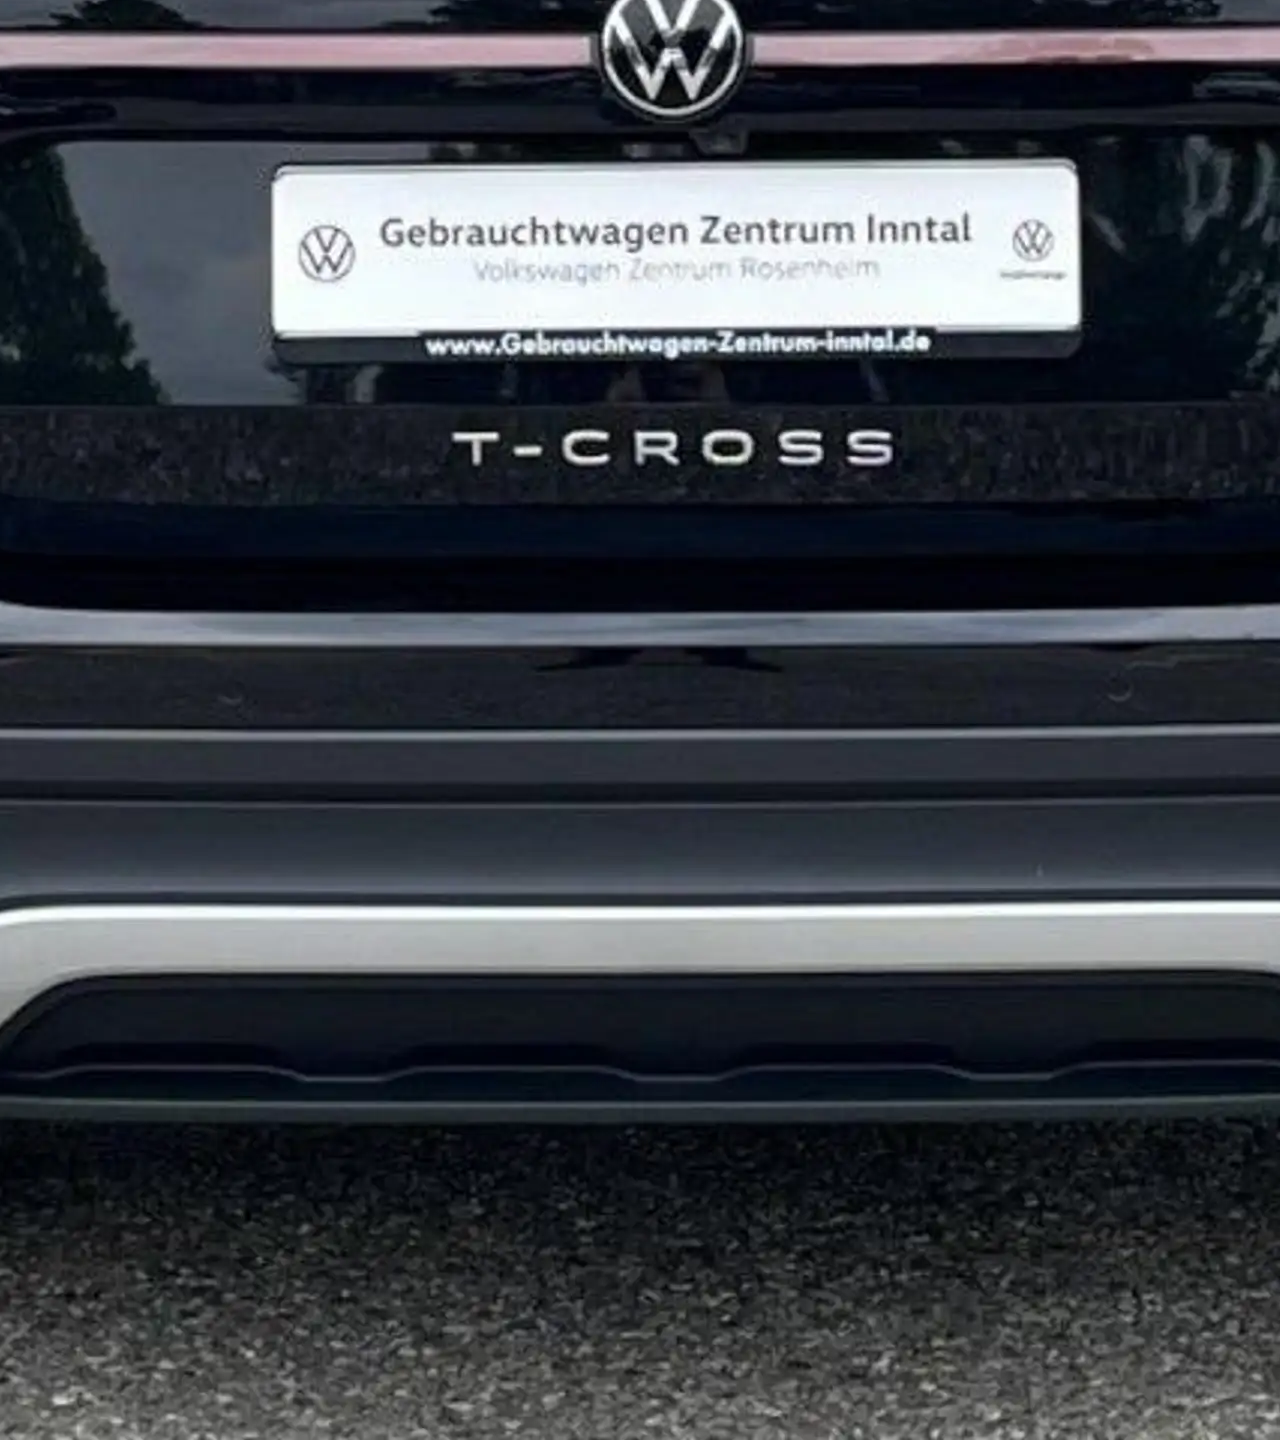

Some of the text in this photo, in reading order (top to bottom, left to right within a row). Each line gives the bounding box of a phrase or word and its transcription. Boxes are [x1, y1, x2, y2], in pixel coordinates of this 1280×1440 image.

[379, 210, 973, 253] Gebrauchtwagen Zentrum Inntal
[474, 256, 882, 287] Volkswagen Zentrum Rosenheim
[451, 429, 895, 467] T-CROSS
